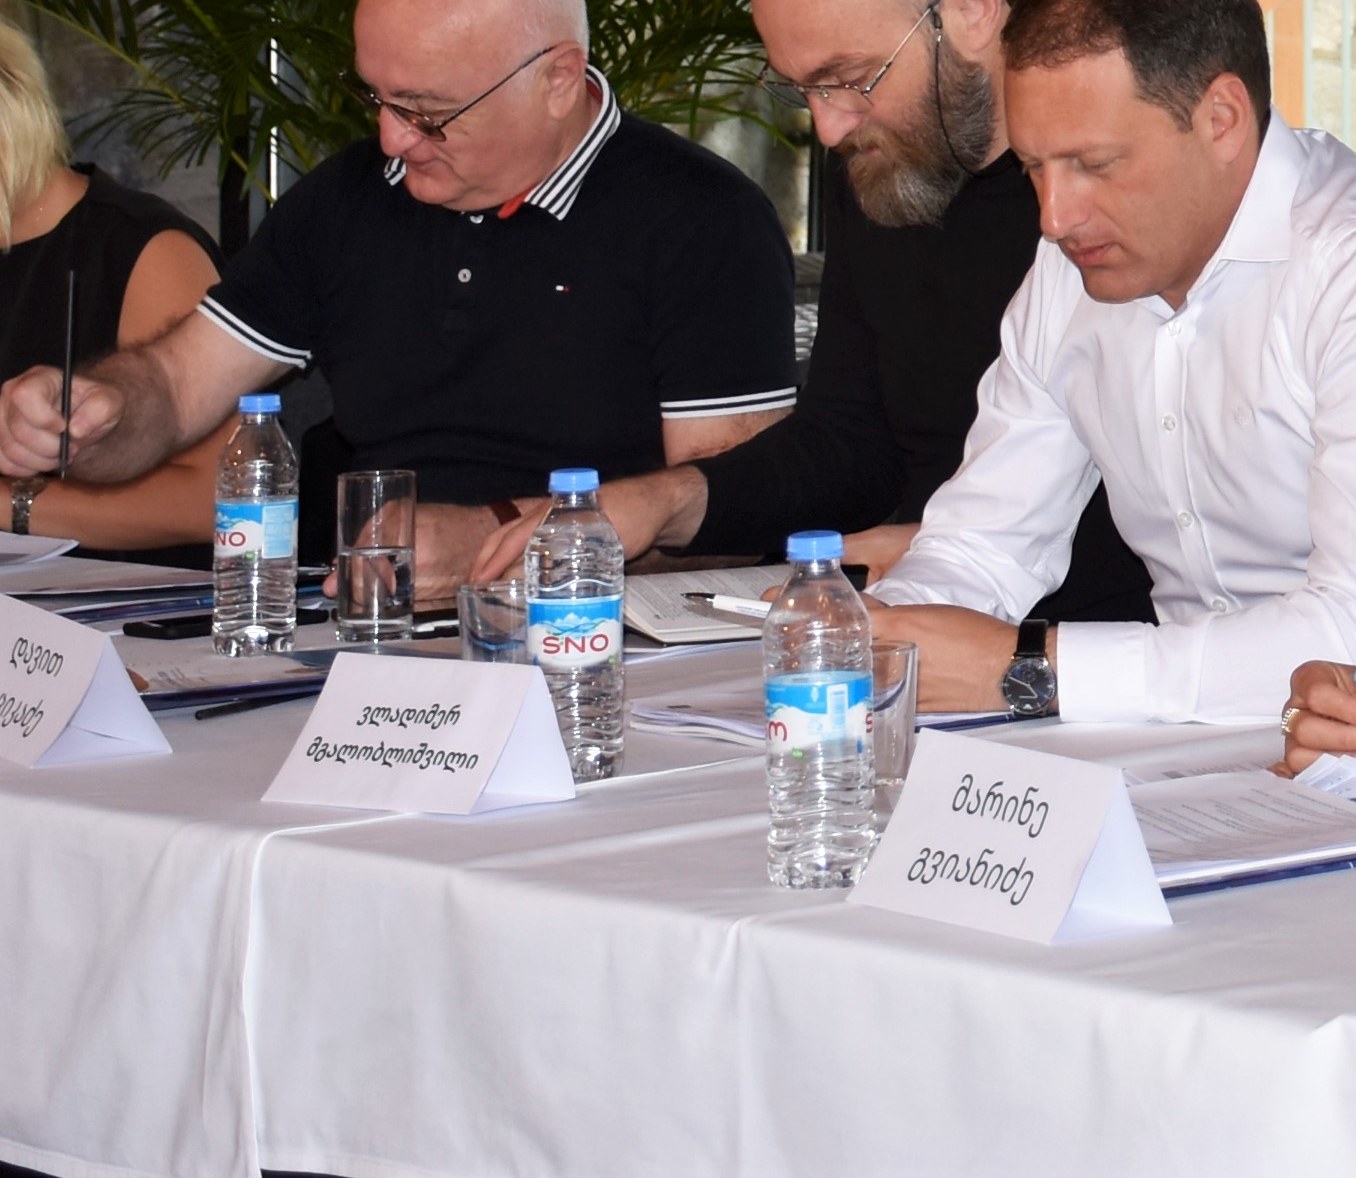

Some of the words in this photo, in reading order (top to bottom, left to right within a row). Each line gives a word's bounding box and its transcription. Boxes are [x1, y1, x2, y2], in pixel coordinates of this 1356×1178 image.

[215, 531, 246, 547] NO
[9, 637, 64, 677] დავით
[543, 633, 609, 654] SNO
[356, 703, 461, 730] ვლადიმერ
[306, 736, 479, 773] მგალობლიშვილი
[952, 773, 1049, 838] მარინე
[907, 847, 1034, 906] გვიანიძე
